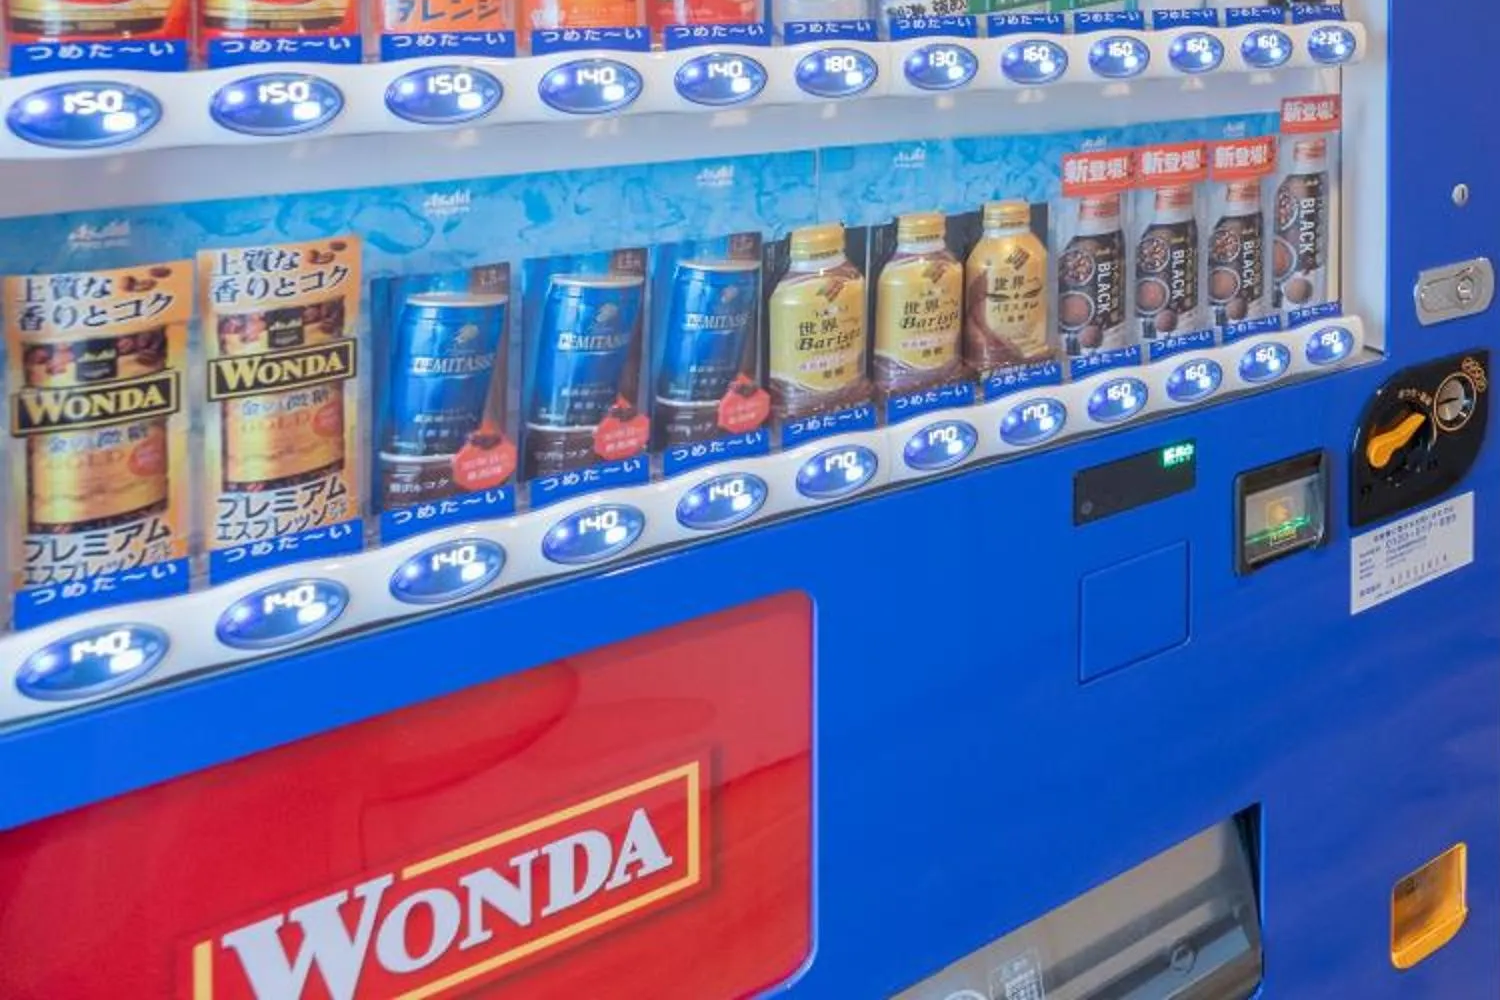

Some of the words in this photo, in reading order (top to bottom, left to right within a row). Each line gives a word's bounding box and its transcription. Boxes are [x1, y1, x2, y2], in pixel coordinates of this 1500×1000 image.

[824, 56, 856, 72] 180
[929, 51, 958, 67] 130
[1023, 46, 1049, 61] 160
[576, 67, 617, 86] 140
[708, 60, 743, 78] 140
[258, 82, 310, 104] 150
[428, 73, 473, 95] 150
[63, 90, 124, 114] 150
[1143, 149, 1200, 174] 新登場!
[1215, 144, 1268, 169] 新登場!
[1065, 158, 1127, 183] 新登場!
[1299, 198, 1316, 255] BLACK
[212, 249, 299, 276] 上質な
[1172, 249, 1185, 300] BLACK
[1241, 240, 1254, 287] BLACK
[17, 277, 112, 302] 上質な
[214, 265, 348, 302] 香りとコク
[1097, 263, 1111, 314] BLACK
[19, 293, 173, 331] 香りとコク
[218, 352, 344, 390] WONDA
[20, 383, 165, 425] WONDA
[1022, 403, 1049, 422] 170
[929, 426, 957, 445] 170
[825, 451, 857, 472] 170
[217, 476, 346, 519] プレミアム
[708, 479, 744, 501] 140
[579, 510, 619, 533] 140
[23, 518, 171, 563] プレミアム
[432, 545, 476, 571] 140
[263, 584, 316, 614] 140
[70, 630, 131, 663] 140
[222, 808, 673, 1000] WONDA
